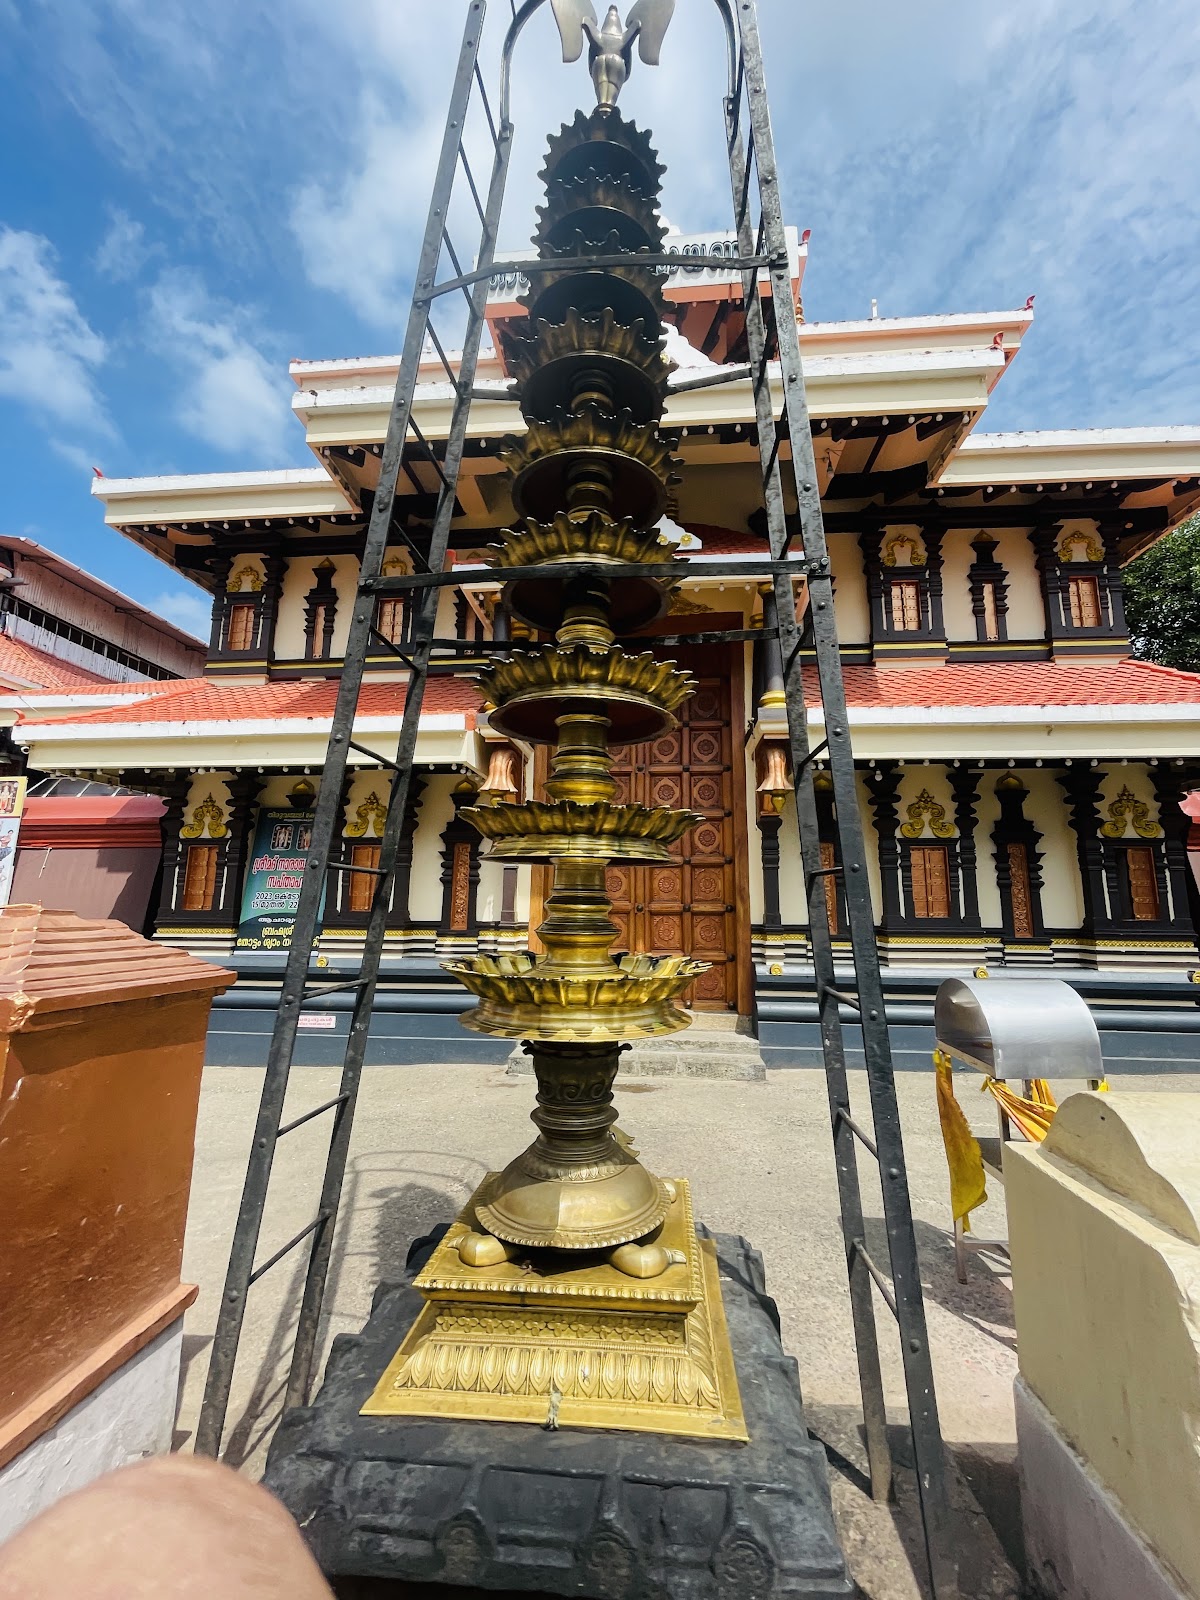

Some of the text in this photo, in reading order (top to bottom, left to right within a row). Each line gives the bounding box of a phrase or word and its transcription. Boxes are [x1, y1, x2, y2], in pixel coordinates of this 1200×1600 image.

[252, 854, 306, 874] ശ്രീമദ് നാരായ
[266, 872, 303, 889] സപ്താഹ
[256, 892, 300, 900] 2023 ഒക്ടോ
[251, 901, 259, 909] 15
[288, 901, 298, 909] 22
[236, 938, 261, 949] തോട്ടം
[263, 938, 280, 949] ശ്യാം
